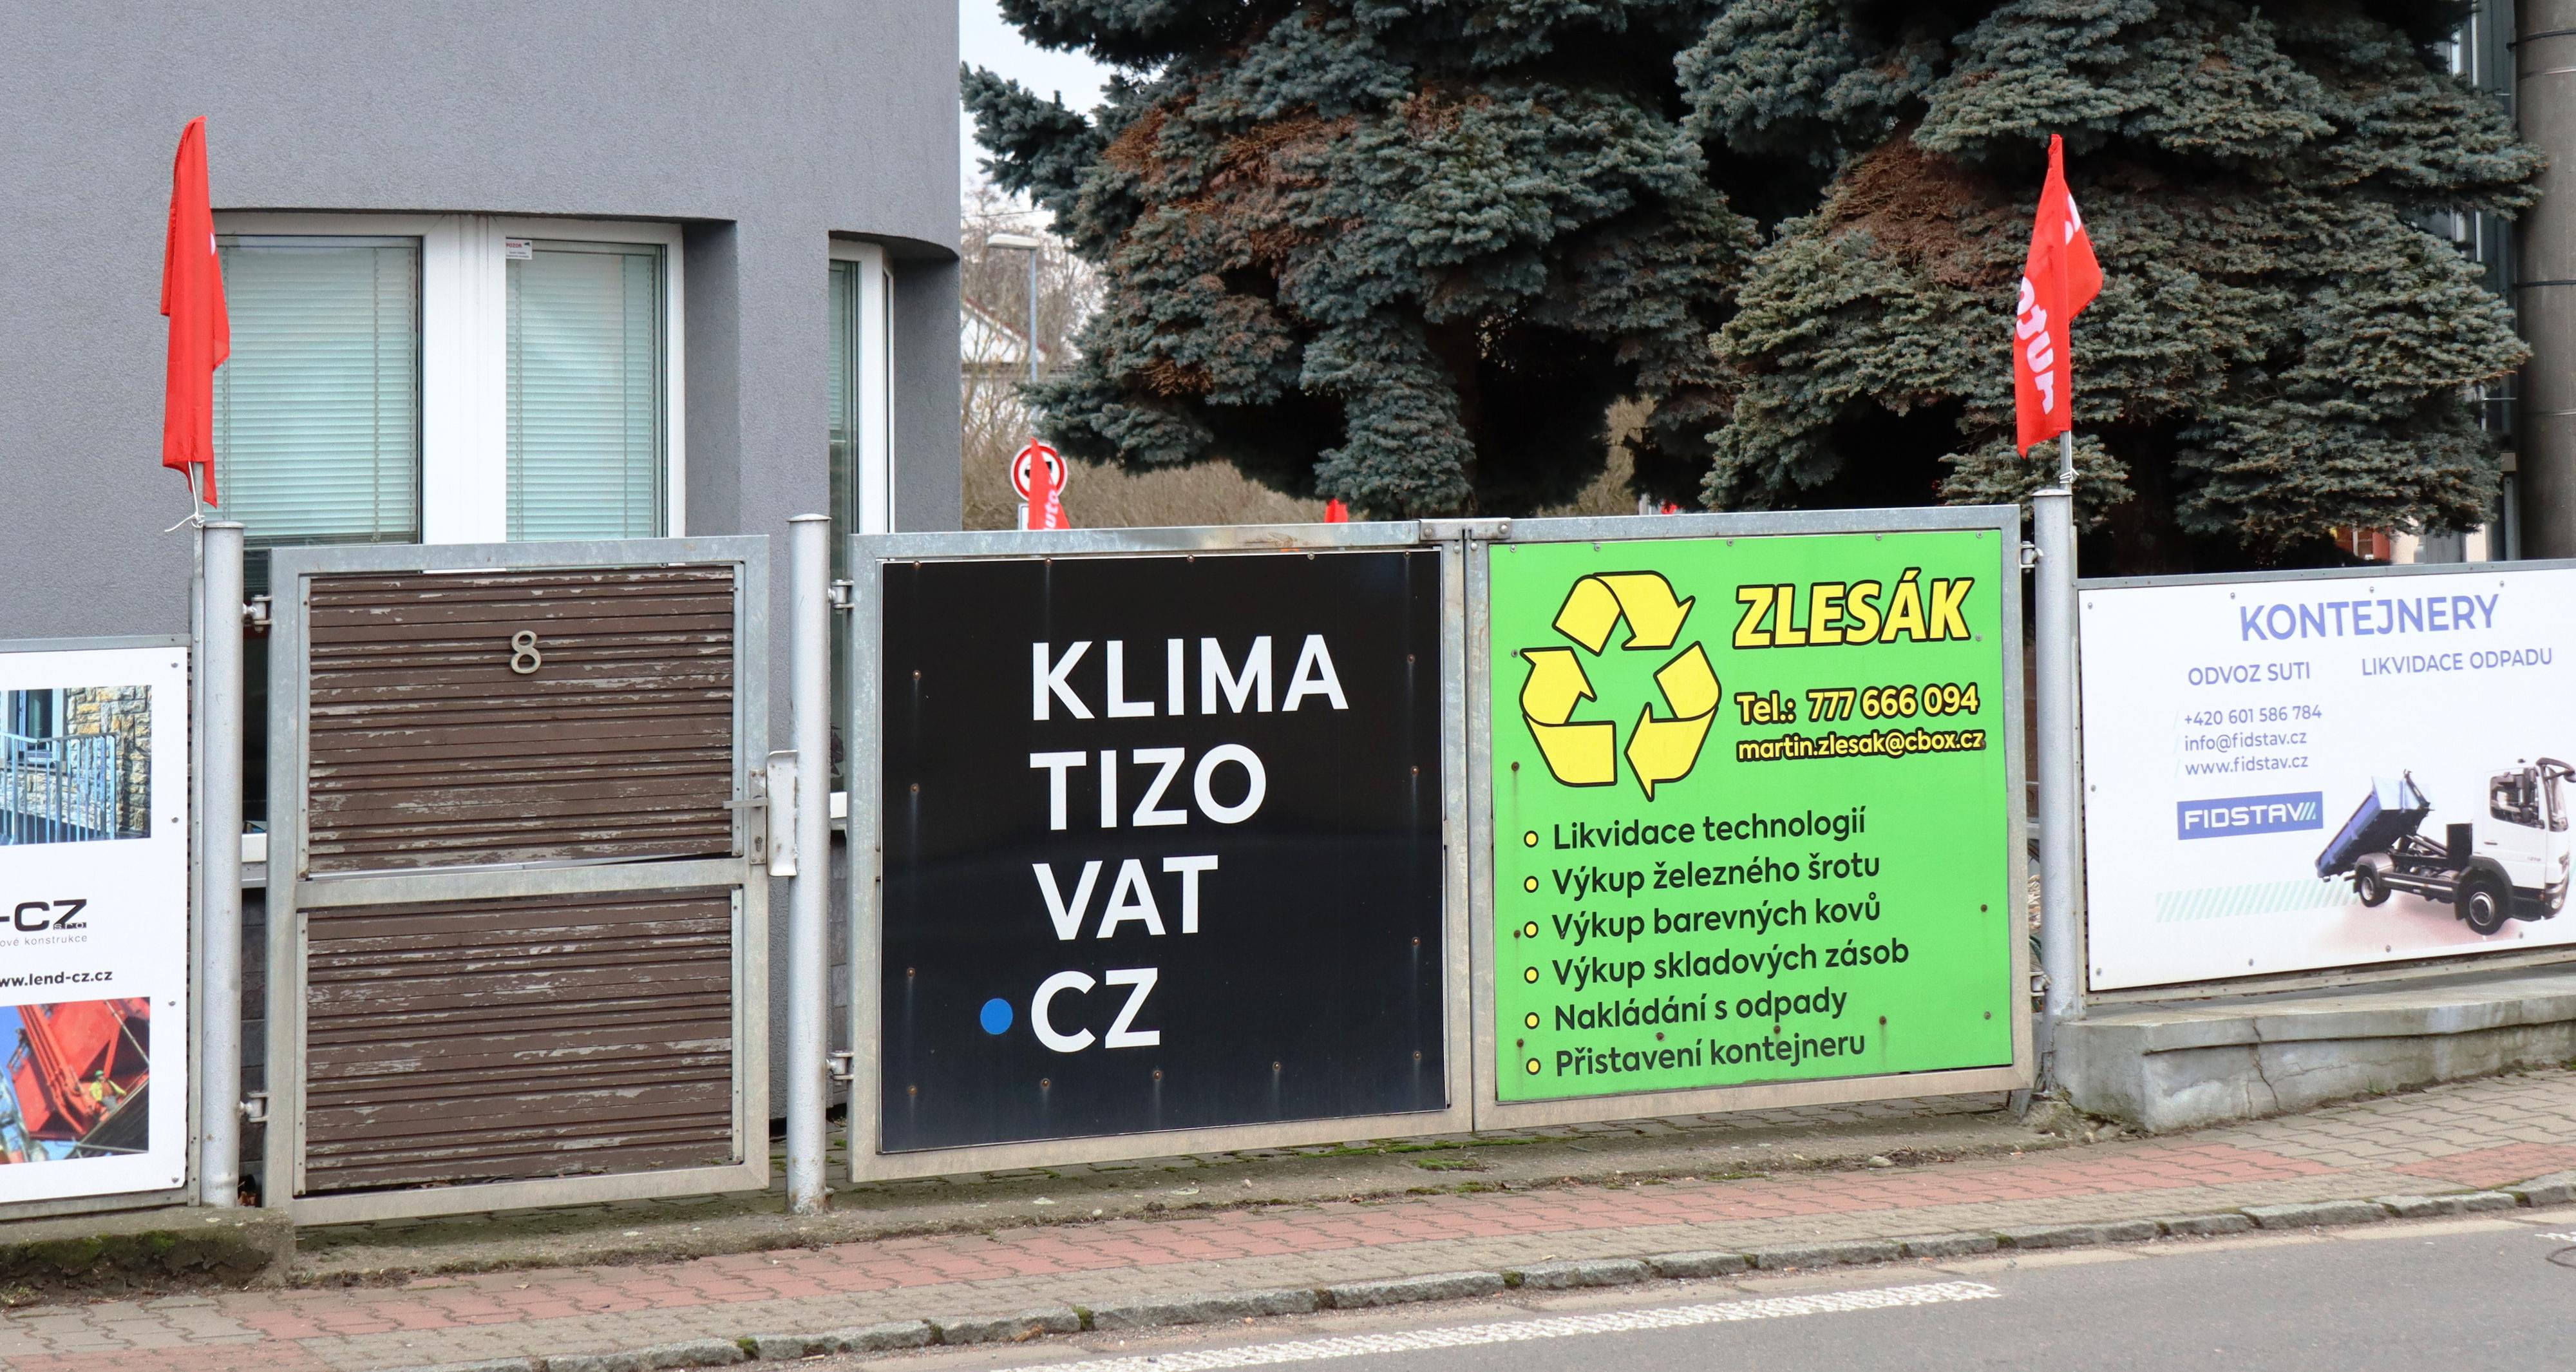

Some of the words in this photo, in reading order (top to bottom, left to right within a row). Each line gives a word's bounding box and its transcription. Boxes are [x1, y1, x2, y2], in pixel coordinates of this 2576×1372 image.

[1732, 567, 1975, 649] ZLESÁK
[2240, 594, 2499, 641] KONTEJNERY
[509, 630, 542, 674] 8
[2188, 665, 2261, 685] ODVOZ
[2268, 662, 2309, 681] SUTI
[2362, 653, 2463, 676] LIKVIDACE
[2470, 648, 2552, 669] ODPADU
[1033, 634, 1349, 720] KLIMA
[1734, 690, 1796, 725] Tel.:
[1806, 687, 1853, 722] 777
[1861, 685, 1917, 719] 666
[1922, 682, 1980, 717] 094
[2185, 710, 2222, 725] +420
[2229, 709, 2253, 724] 601
[2259, 707, 2287, 722] 586
[2292, 705, 2322, 719] 784
[1736, 729, 1983, 762] martin.zlesak@cbox.cz
[2185, 732, 2307, 752] info@fidstav.cz
[1030, 744, 1265, 830] TIZO
[2185, 756, 2308, 775] www.fidstav.cz
[1555, 819, 1694, 849] Likvidace
[1703, 806, 1866, 841] technologií
[2184, 802, 2304, 830] FIDSTAV
[1032, 855, 1218, 940] VAT
[1552, 866, 1644, 901] Výkup
[1654, 856, 1799, 889] železného
[1808, 853, 1879, 880] šrotu
[24, 935, 88, 945] konstrukce
[1552, 911, 1644, 944] Výkup
[1654, 900, 1806, 935] barevných
[1816, 892, 1879, 923] kovů
[1552, 957, 1645, 991] Výkup
[1654, 944, 1816, 978] skladových
[1826, 938, 1908, 967] zásob
[1556, 993, 1707, 1031] Nakládání
[1715, 1000, 1727, 1020] s
[1736, 987, 1847, 1022] odpady
[1557, 1039, 1702, 1076] Přistavení
[1711, 1031, 1864, 1067] kontejneru
